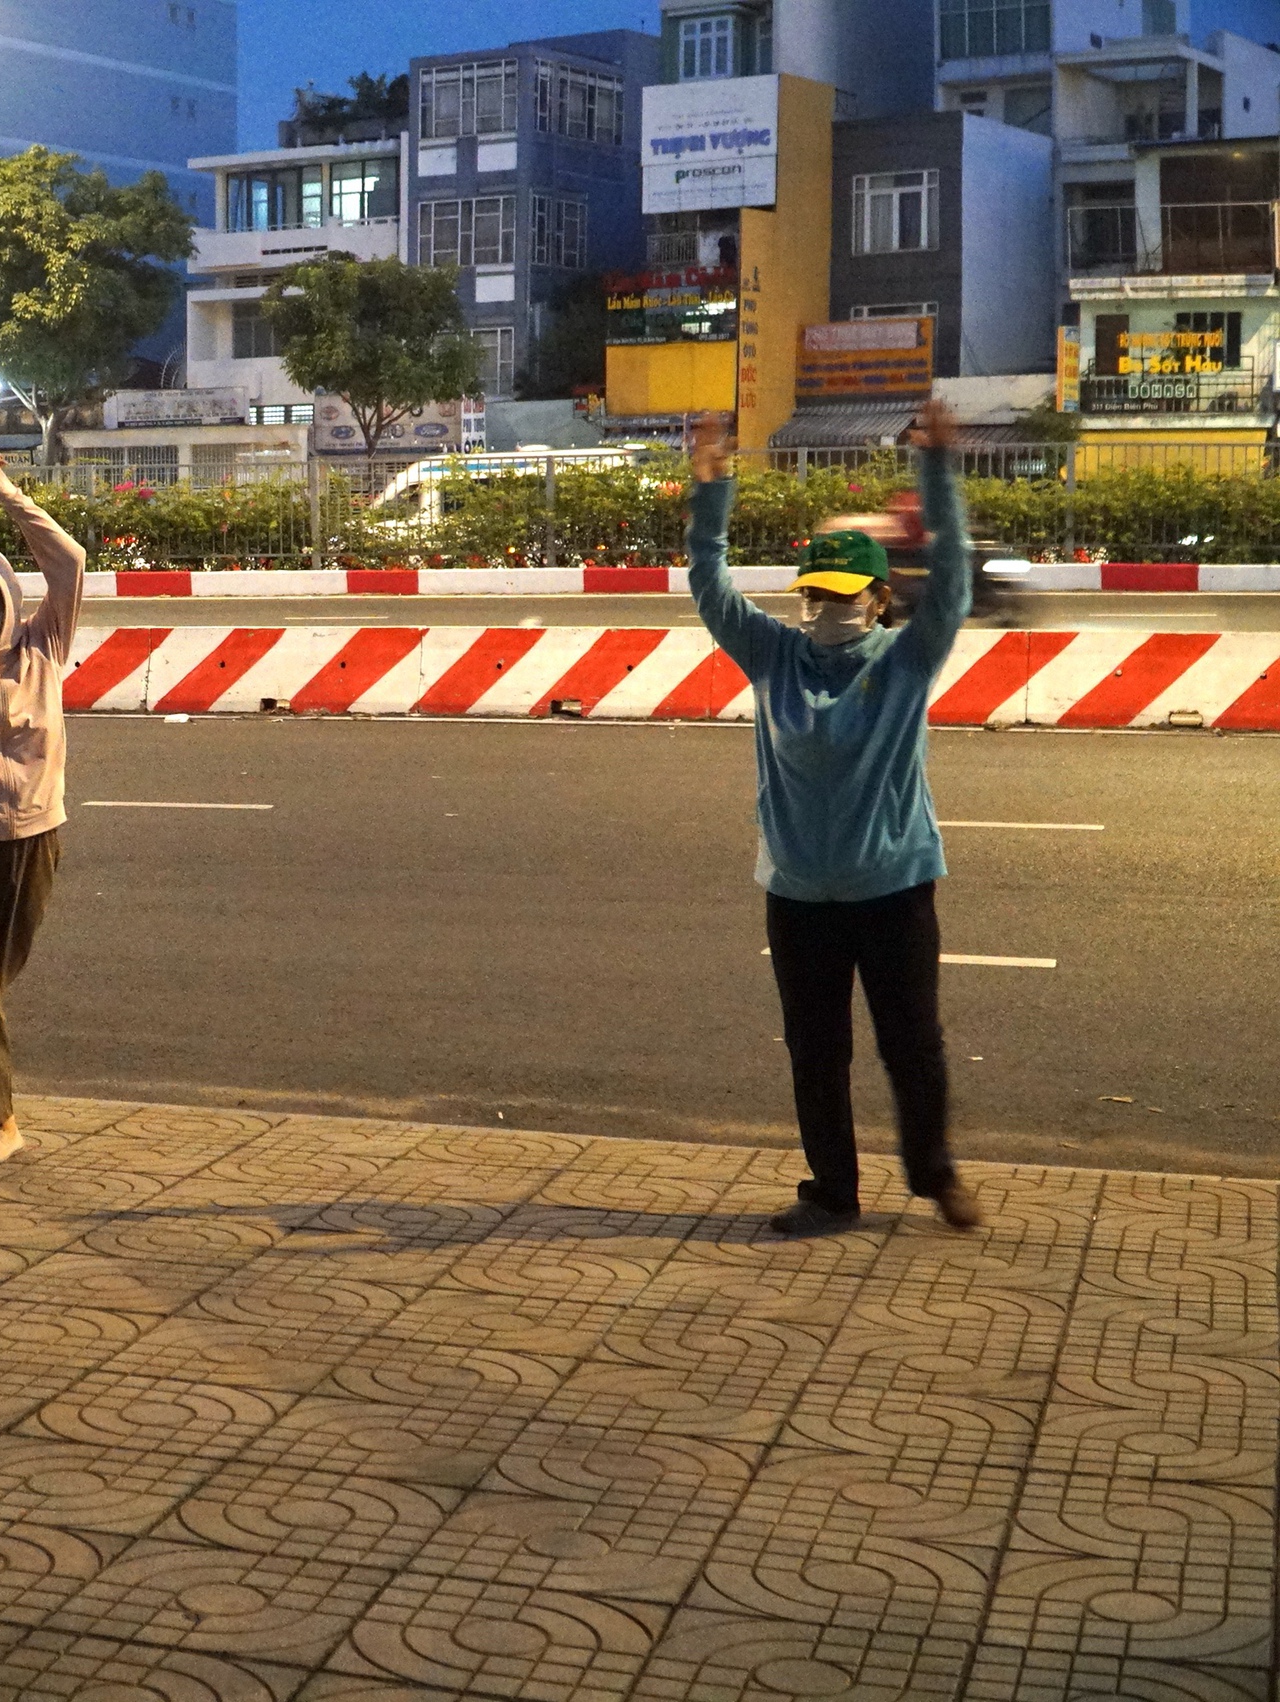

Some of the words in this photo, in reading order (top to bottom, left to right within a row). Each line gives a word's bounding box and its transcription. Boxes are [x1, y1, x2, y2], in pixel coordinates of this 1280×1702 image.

[650, 134, 706, 159] THỊNH
[709, 128, 771, 155] VƯỢNG
[675, 164, 742, 184] proscon
